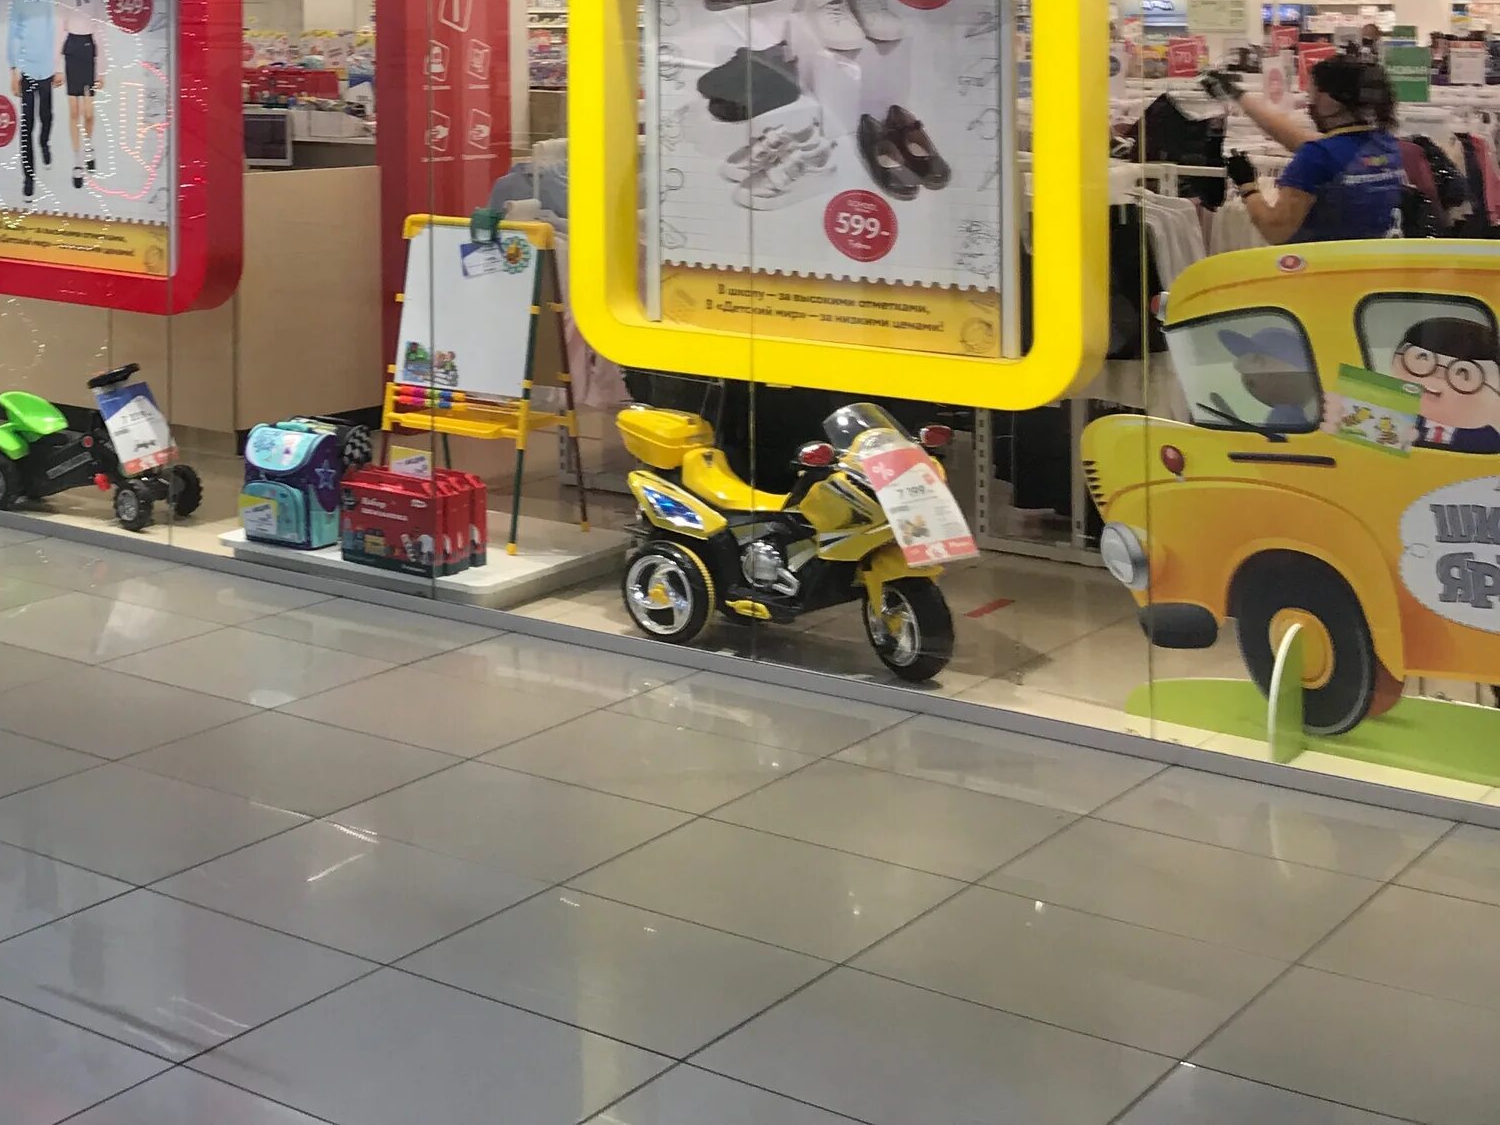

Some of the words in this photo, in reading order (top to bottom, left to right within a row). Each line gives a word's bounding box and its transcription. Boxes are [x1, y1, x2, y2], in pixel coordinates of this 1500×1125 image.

[728, 286, 764, 300] школу
[793, 292, 856, 308] высокими
[836, 313, 890, 327] низкими
[1436, 551, 1500, 610] ЯР
